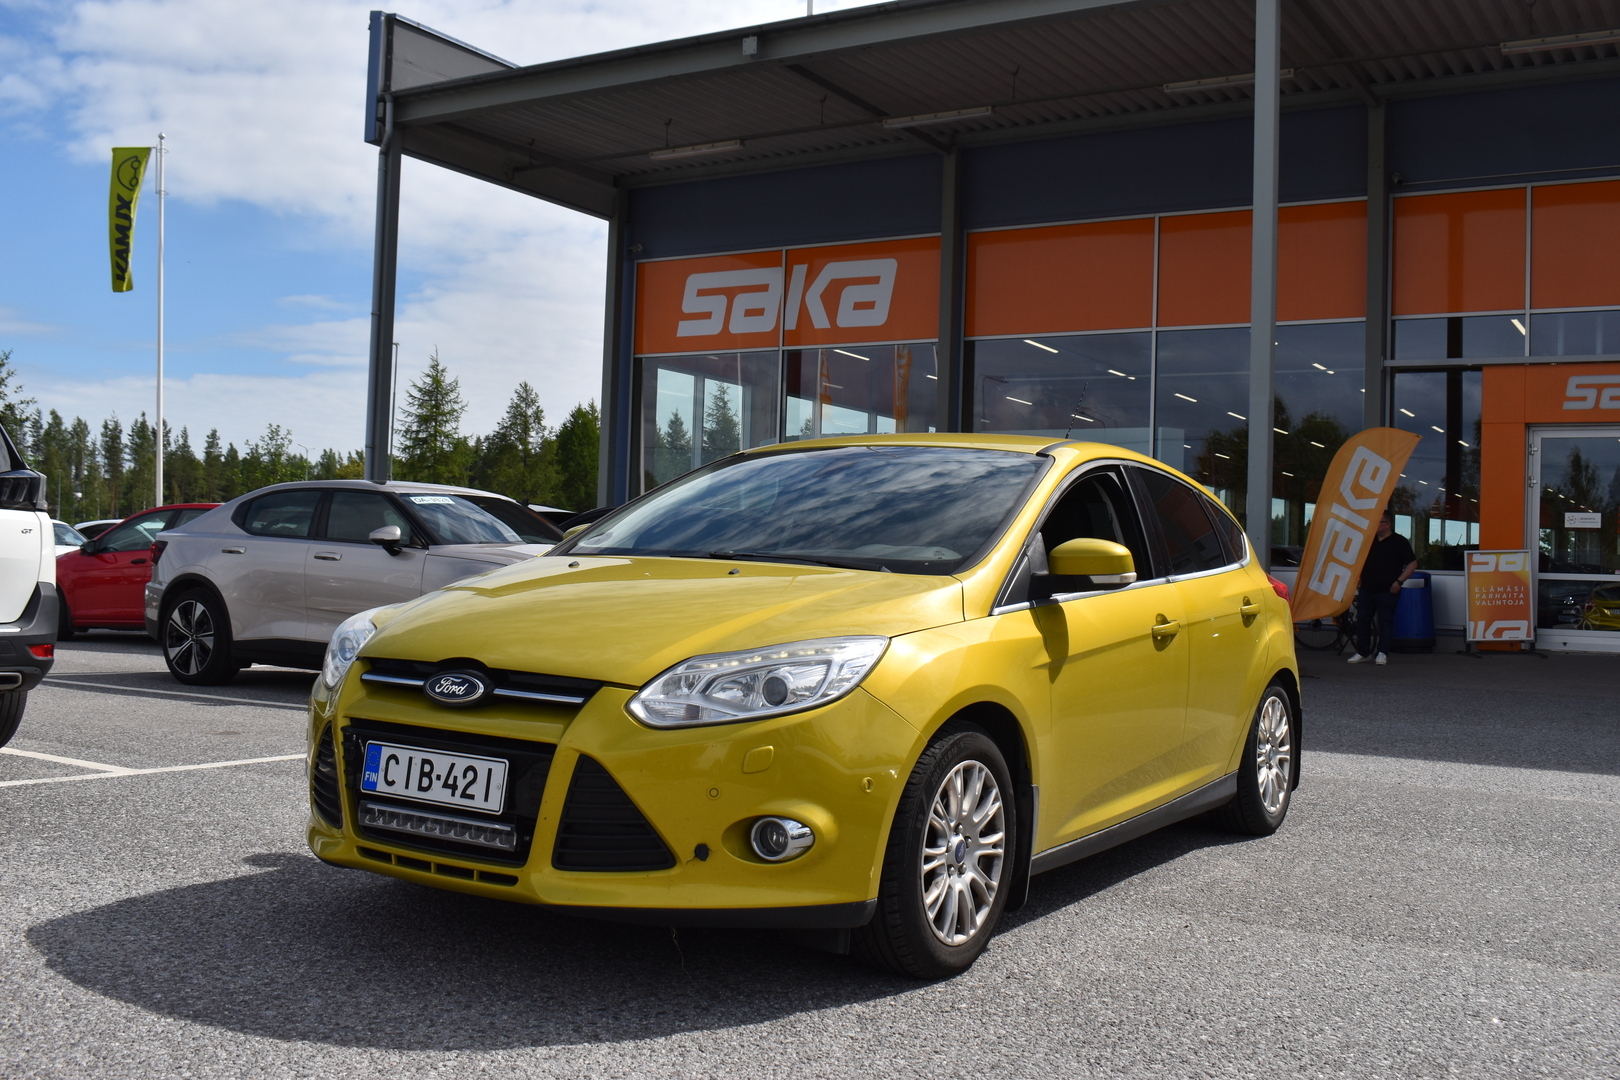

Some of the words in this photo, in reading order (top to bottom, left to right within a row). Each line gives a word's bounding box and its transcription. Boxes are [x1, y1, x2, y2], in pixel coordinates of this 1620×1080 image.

[115, 193, 132, 282] KAMUX
[1475, 585, 1524, 593] ELÄMÄSI
[435, 676, 469, 695] Ford
[365, 771, 378, 783] FIN
[383, 753, 493, 803] CIB-421
